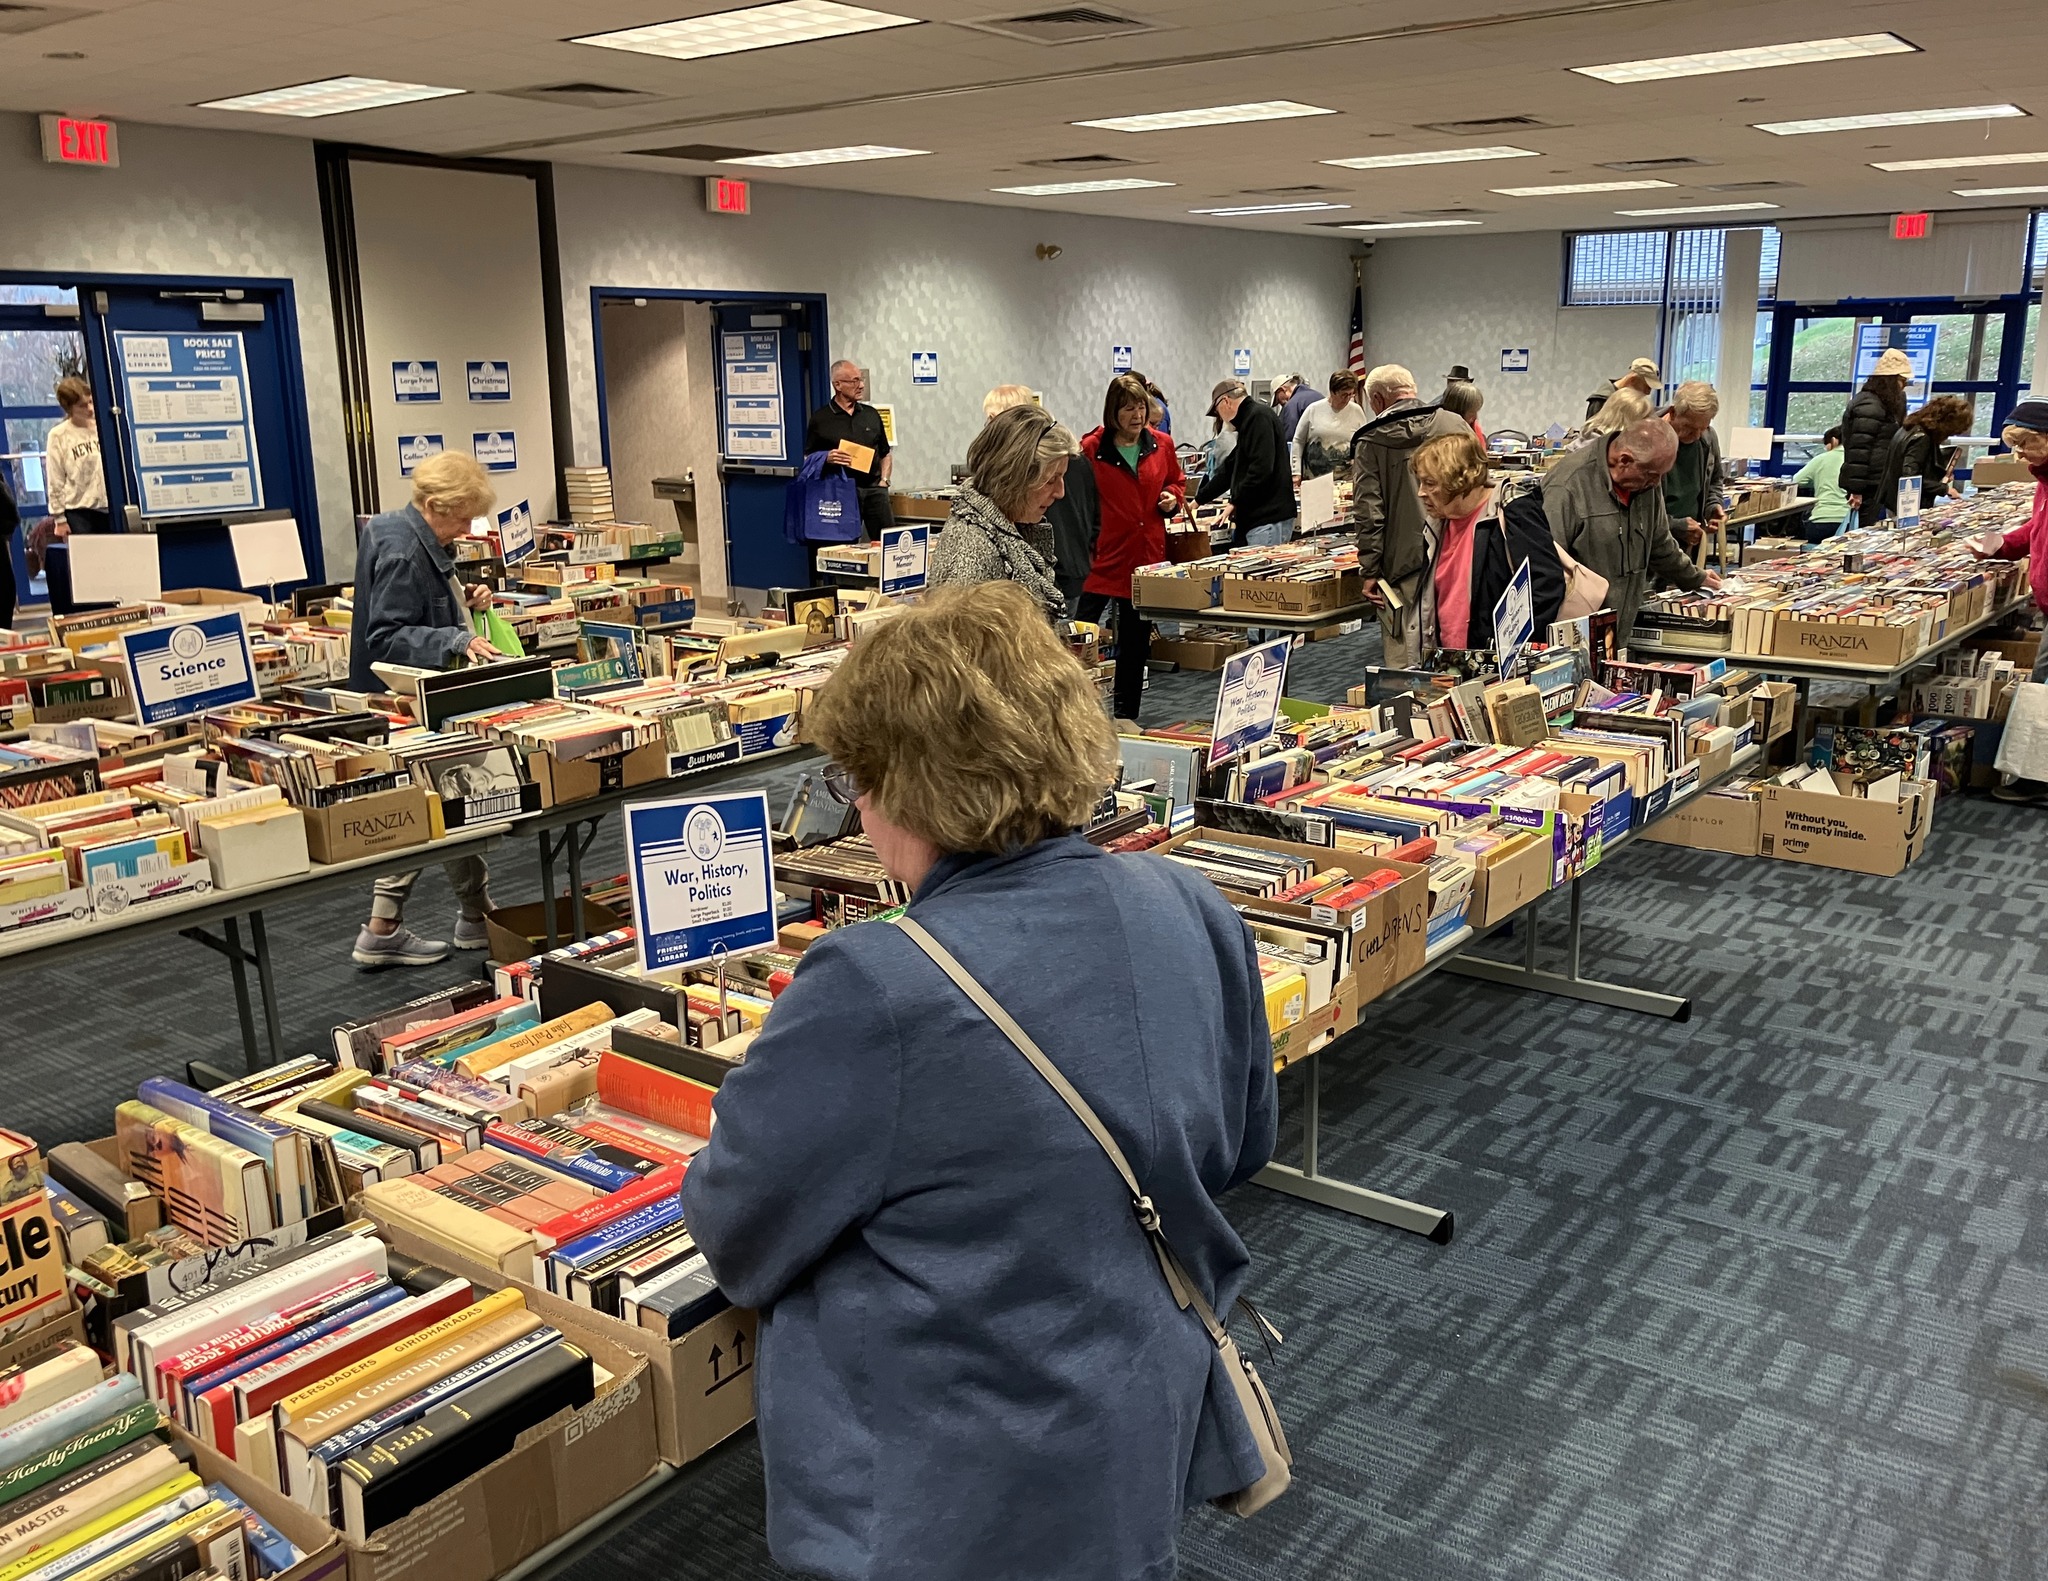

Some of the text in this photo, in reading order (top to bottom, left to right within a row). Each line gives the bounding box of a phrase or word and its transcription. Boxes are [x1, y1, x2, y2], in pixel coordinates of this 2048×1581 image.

[58, 118, 108, 164] EXIT
[718, 179, 746, 213] EXIT
[1895, 214, 1928, 238] EXIT
[183, 338, 233, 348] BOOK SALE
[195, 350, 226, 359] PRICES
[400, 377, 417, 385] Large
[72, 441, 93, 461] NEW
[1240, 588, 1287, 603] FRANZIA
[65, 611, 141, 632] THE LIFE OF CHRIST
[1800, 632, 1868, 650] FRANZIA
[160, 657, 226, 681] Science
[263, 666, 309, 678] WHITE CLAW
[1230, 688, 1269, 708] War, History,
[1543, 692, 1559, 712] GLENN
[1558, 688, 1575, 705] BECK
[1928, 692, 1939, 713] 1000
[1943, 693, 1954, 714] 1000
[1236, 703, 1258, 717] Politics
[687, 751, 725, 768] BLUE MOON
[343, 809, 415, 839] FRANZIA
[1784, 820, 1867, 841] I'm empty inside.
[1785, 810, 1848, 830] Without you,
[1782, 837, 1810, 849] prime
[140, 874, 190, 889] WHITE CLAW
[664, 863, 748, 885] War, History,
[689, 884, 732, 902] Politics
[10, 900, 65, 916] WHITE CLAW
[656, 943, 688, 955] FRIENDS
[657, 951, 689, 963] LIBRARY
[510, 1019, 574, 1050] John Paul Jones
[580, 1181, 674, 1223] Political Dictionary
[653, 1204, 680, 1218] Century
[592, 1205, 655, 1238] WELLESLEY
[587, 1229, 663, 1271] IN THE GARDEN OF
[628, 1247, 675, 1271] PREQUEL
[636, 1286, 649, 1295] A
[650, 1255, 705, 1287] Warning
[42, 1326, 74, 1349] LITERS
[181, 1318, 292, 1371] JESSE VENTURA
[178, 1345, 201, 1361] BILL
[289, 1358, 378, 1405] PERSUADERS
[394, 1306, 483, 1352] GIRIDHARADAS
[426, 1339, 530, 1395] ELIZABETH WARREN
[303, 1342, 465, 1431] Alan Greenspan
[0, 1413, 50, 1438] MITCHELL
[7, 1446, 67, 1486] Hardly
[66, 1427, 116, 1456] Knew
[58, 1471, 96, 1492] GEORGE
[16, 1504, 70, 1537] MASTER
[175, 1506, 214, 1527] USED
